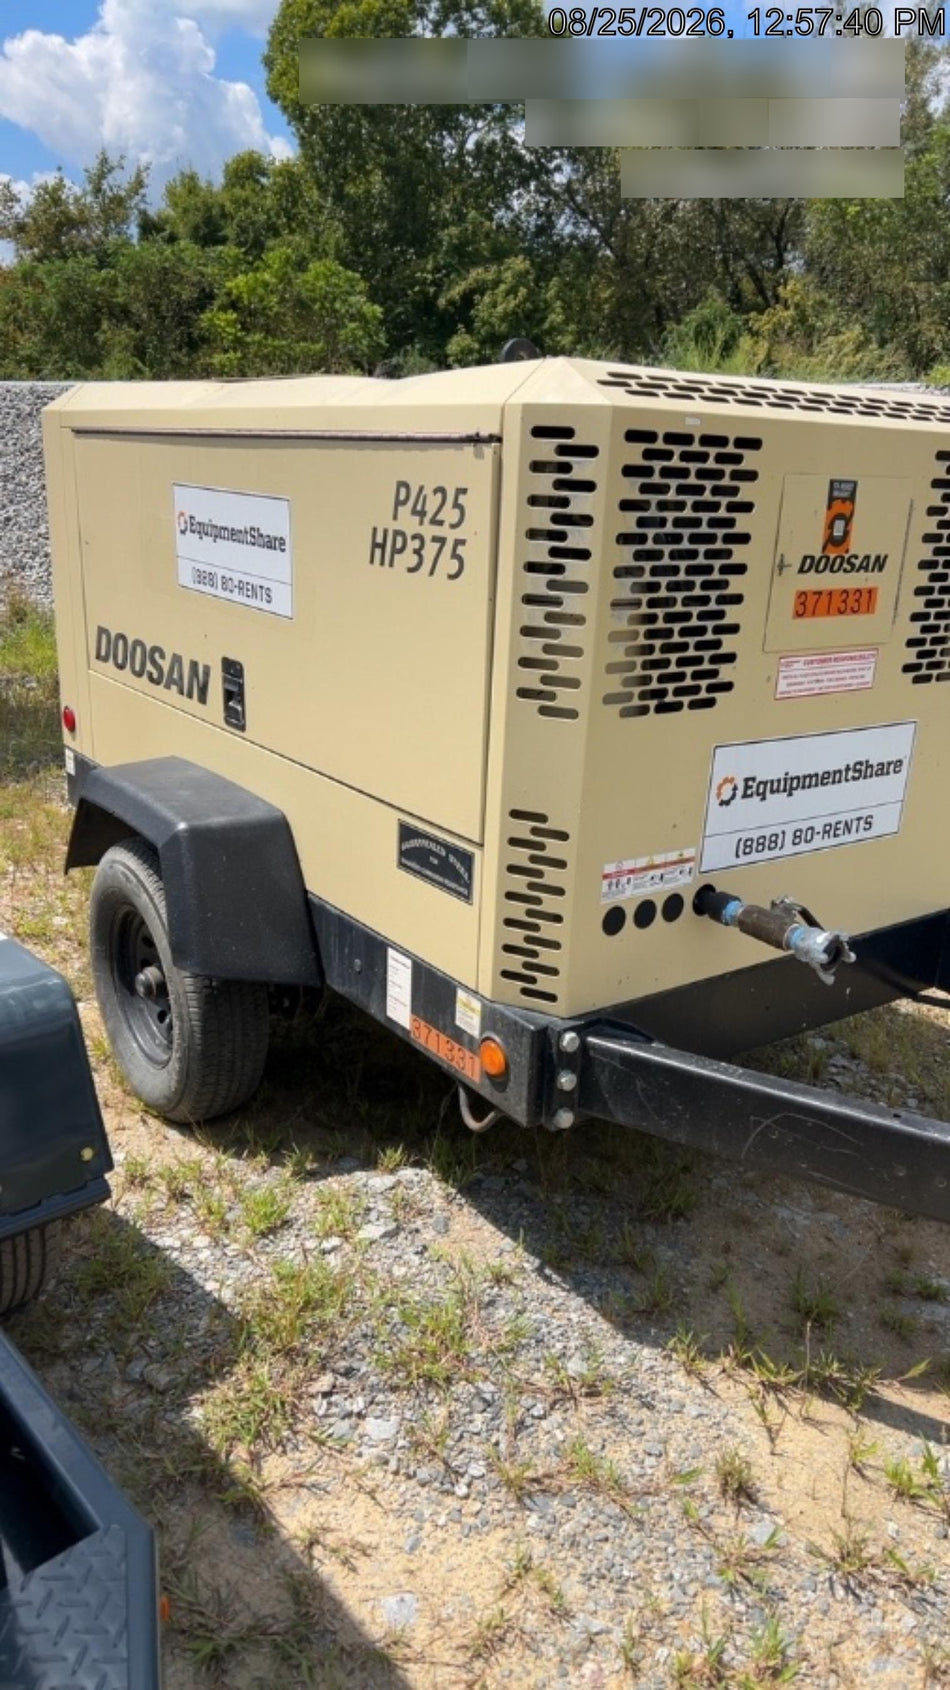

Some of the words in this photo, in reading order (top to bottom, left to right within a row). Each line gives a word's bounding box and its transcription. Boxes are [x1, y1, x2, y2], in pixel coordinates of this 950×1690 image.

[392, 480, 468, 530] P425
[188, 514, 287, 553] EquipmentShare
[368, 526, 468, 581] HP375
[192, 566, 218, 591] (888)
[220, 575, 273, 604] 80-RENTS
[797, 554, 888, 574] DOOSAN
[795, 588, 873, 618] 371331
[95, 625, 210, 705] DOOSAN
[740, 757, 904, 802] EquipmentShare
[734, 828, 786, 859] (888)
[791, 814, 874, 848] 80-RENTS
[411, 1016, 477, 1079] 371331
